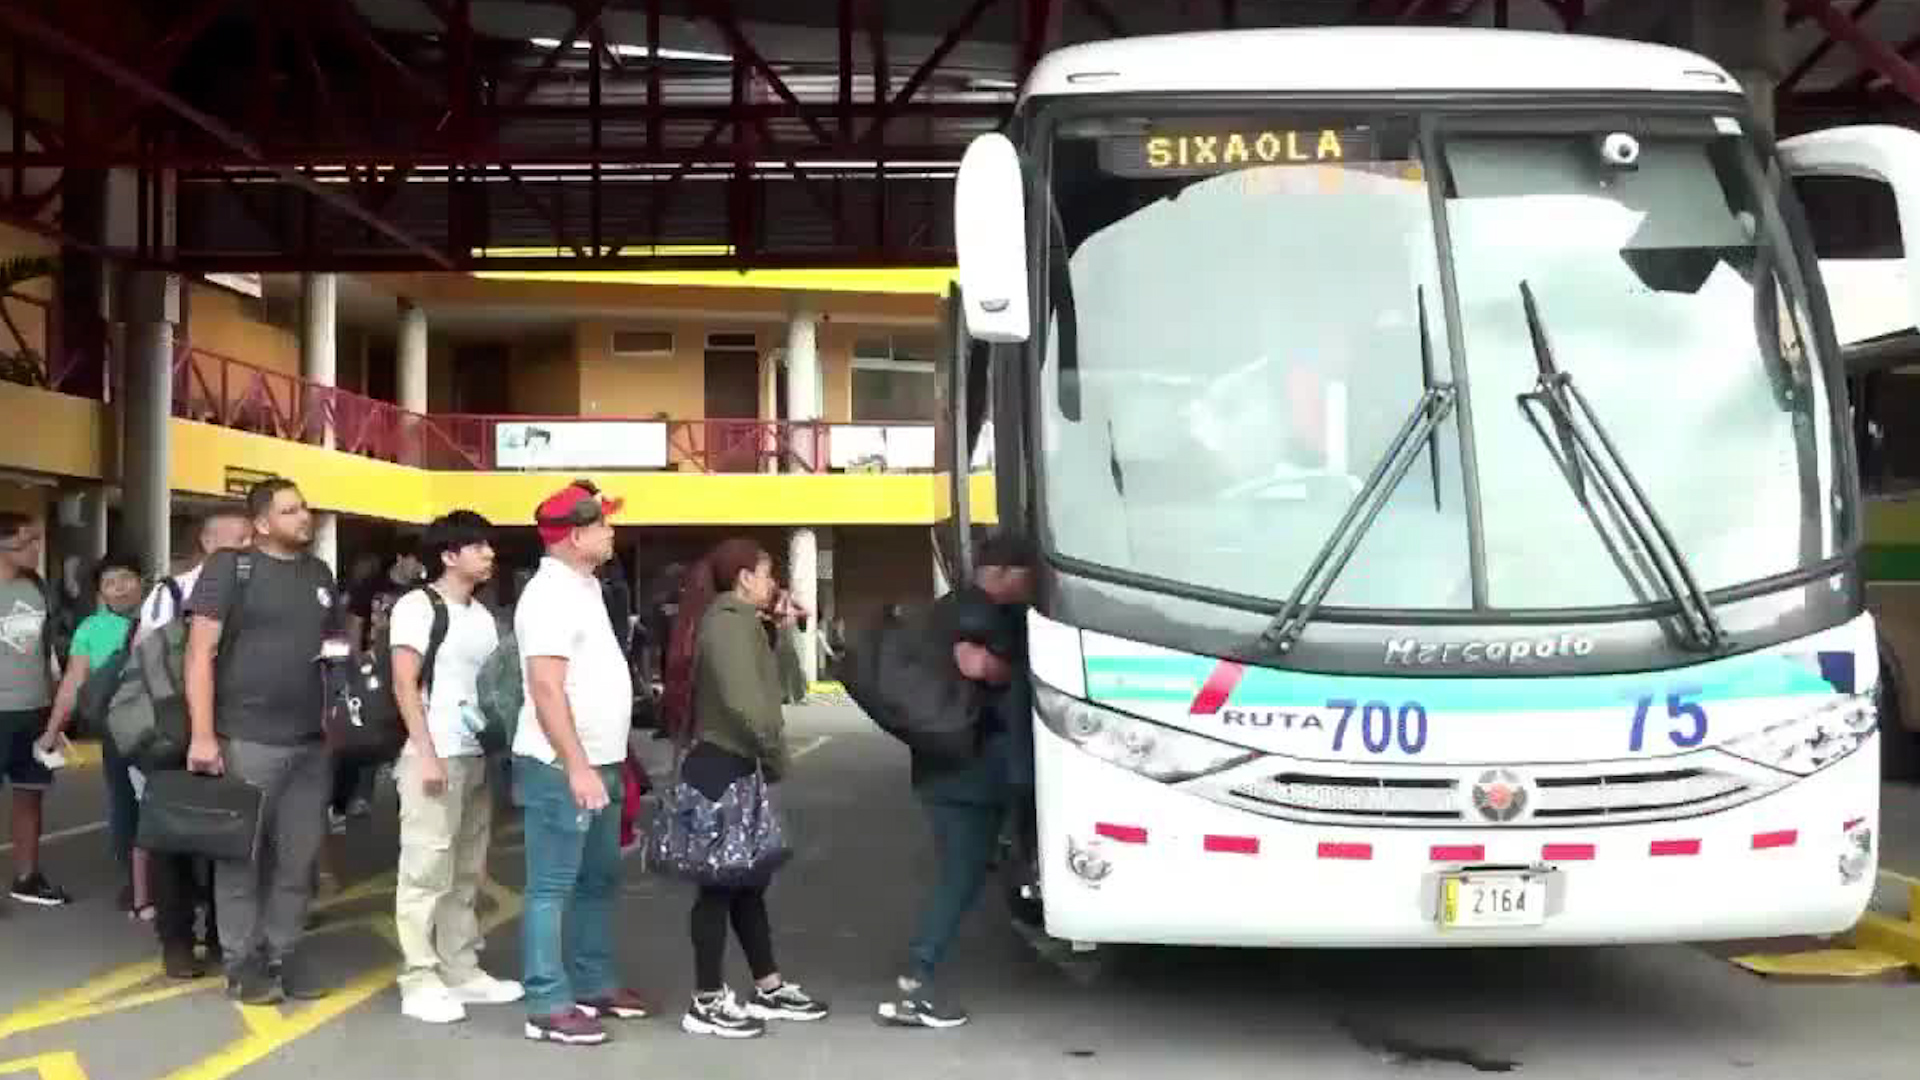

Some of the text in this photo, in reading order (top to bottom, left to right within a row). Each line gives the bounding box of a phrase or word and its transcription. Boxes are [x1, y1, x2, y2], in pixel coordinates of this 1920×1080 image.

[1147, 130, 1342, 167] SIXAOLA
[1223, 699, 1428, 754] RUTA 700
[1625, 684, 1708, 752] 75
[1472, 889, 1525, 913] 2164
